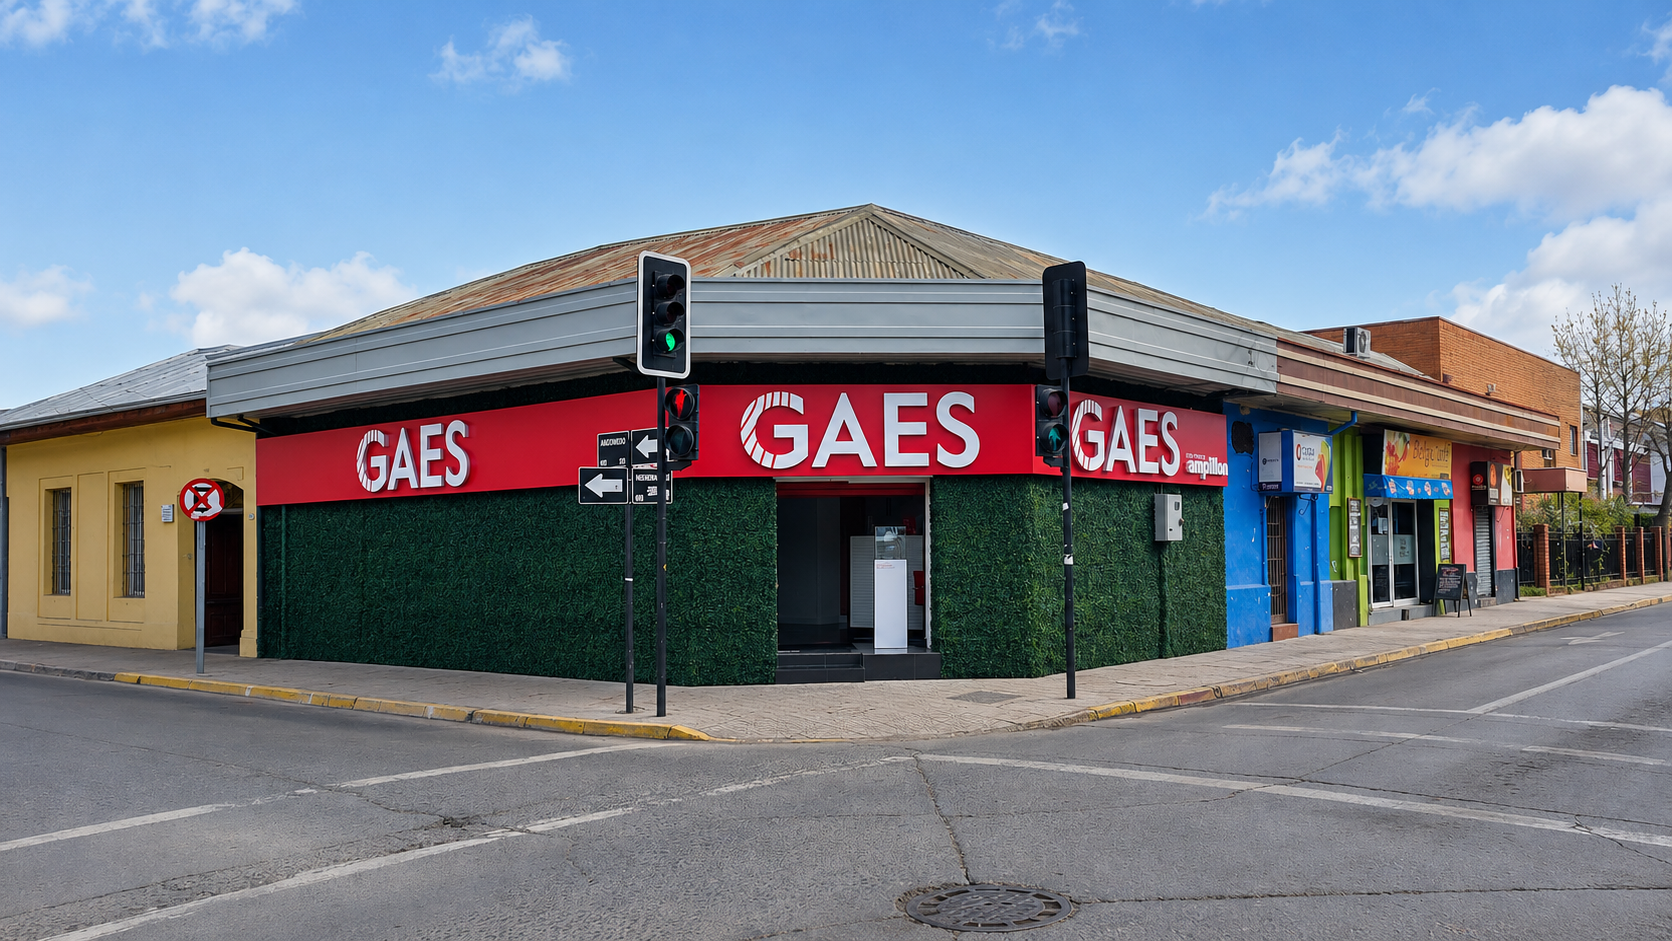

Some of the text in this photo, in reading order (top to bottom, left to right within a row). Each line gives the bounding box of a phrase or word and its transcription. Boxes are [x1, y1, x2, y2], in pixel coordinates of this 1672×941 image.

[356, 419, 471, 493] GAES
[740, 391, 981, 470] GAES
[1071, 399, 1181, 477] GAES
